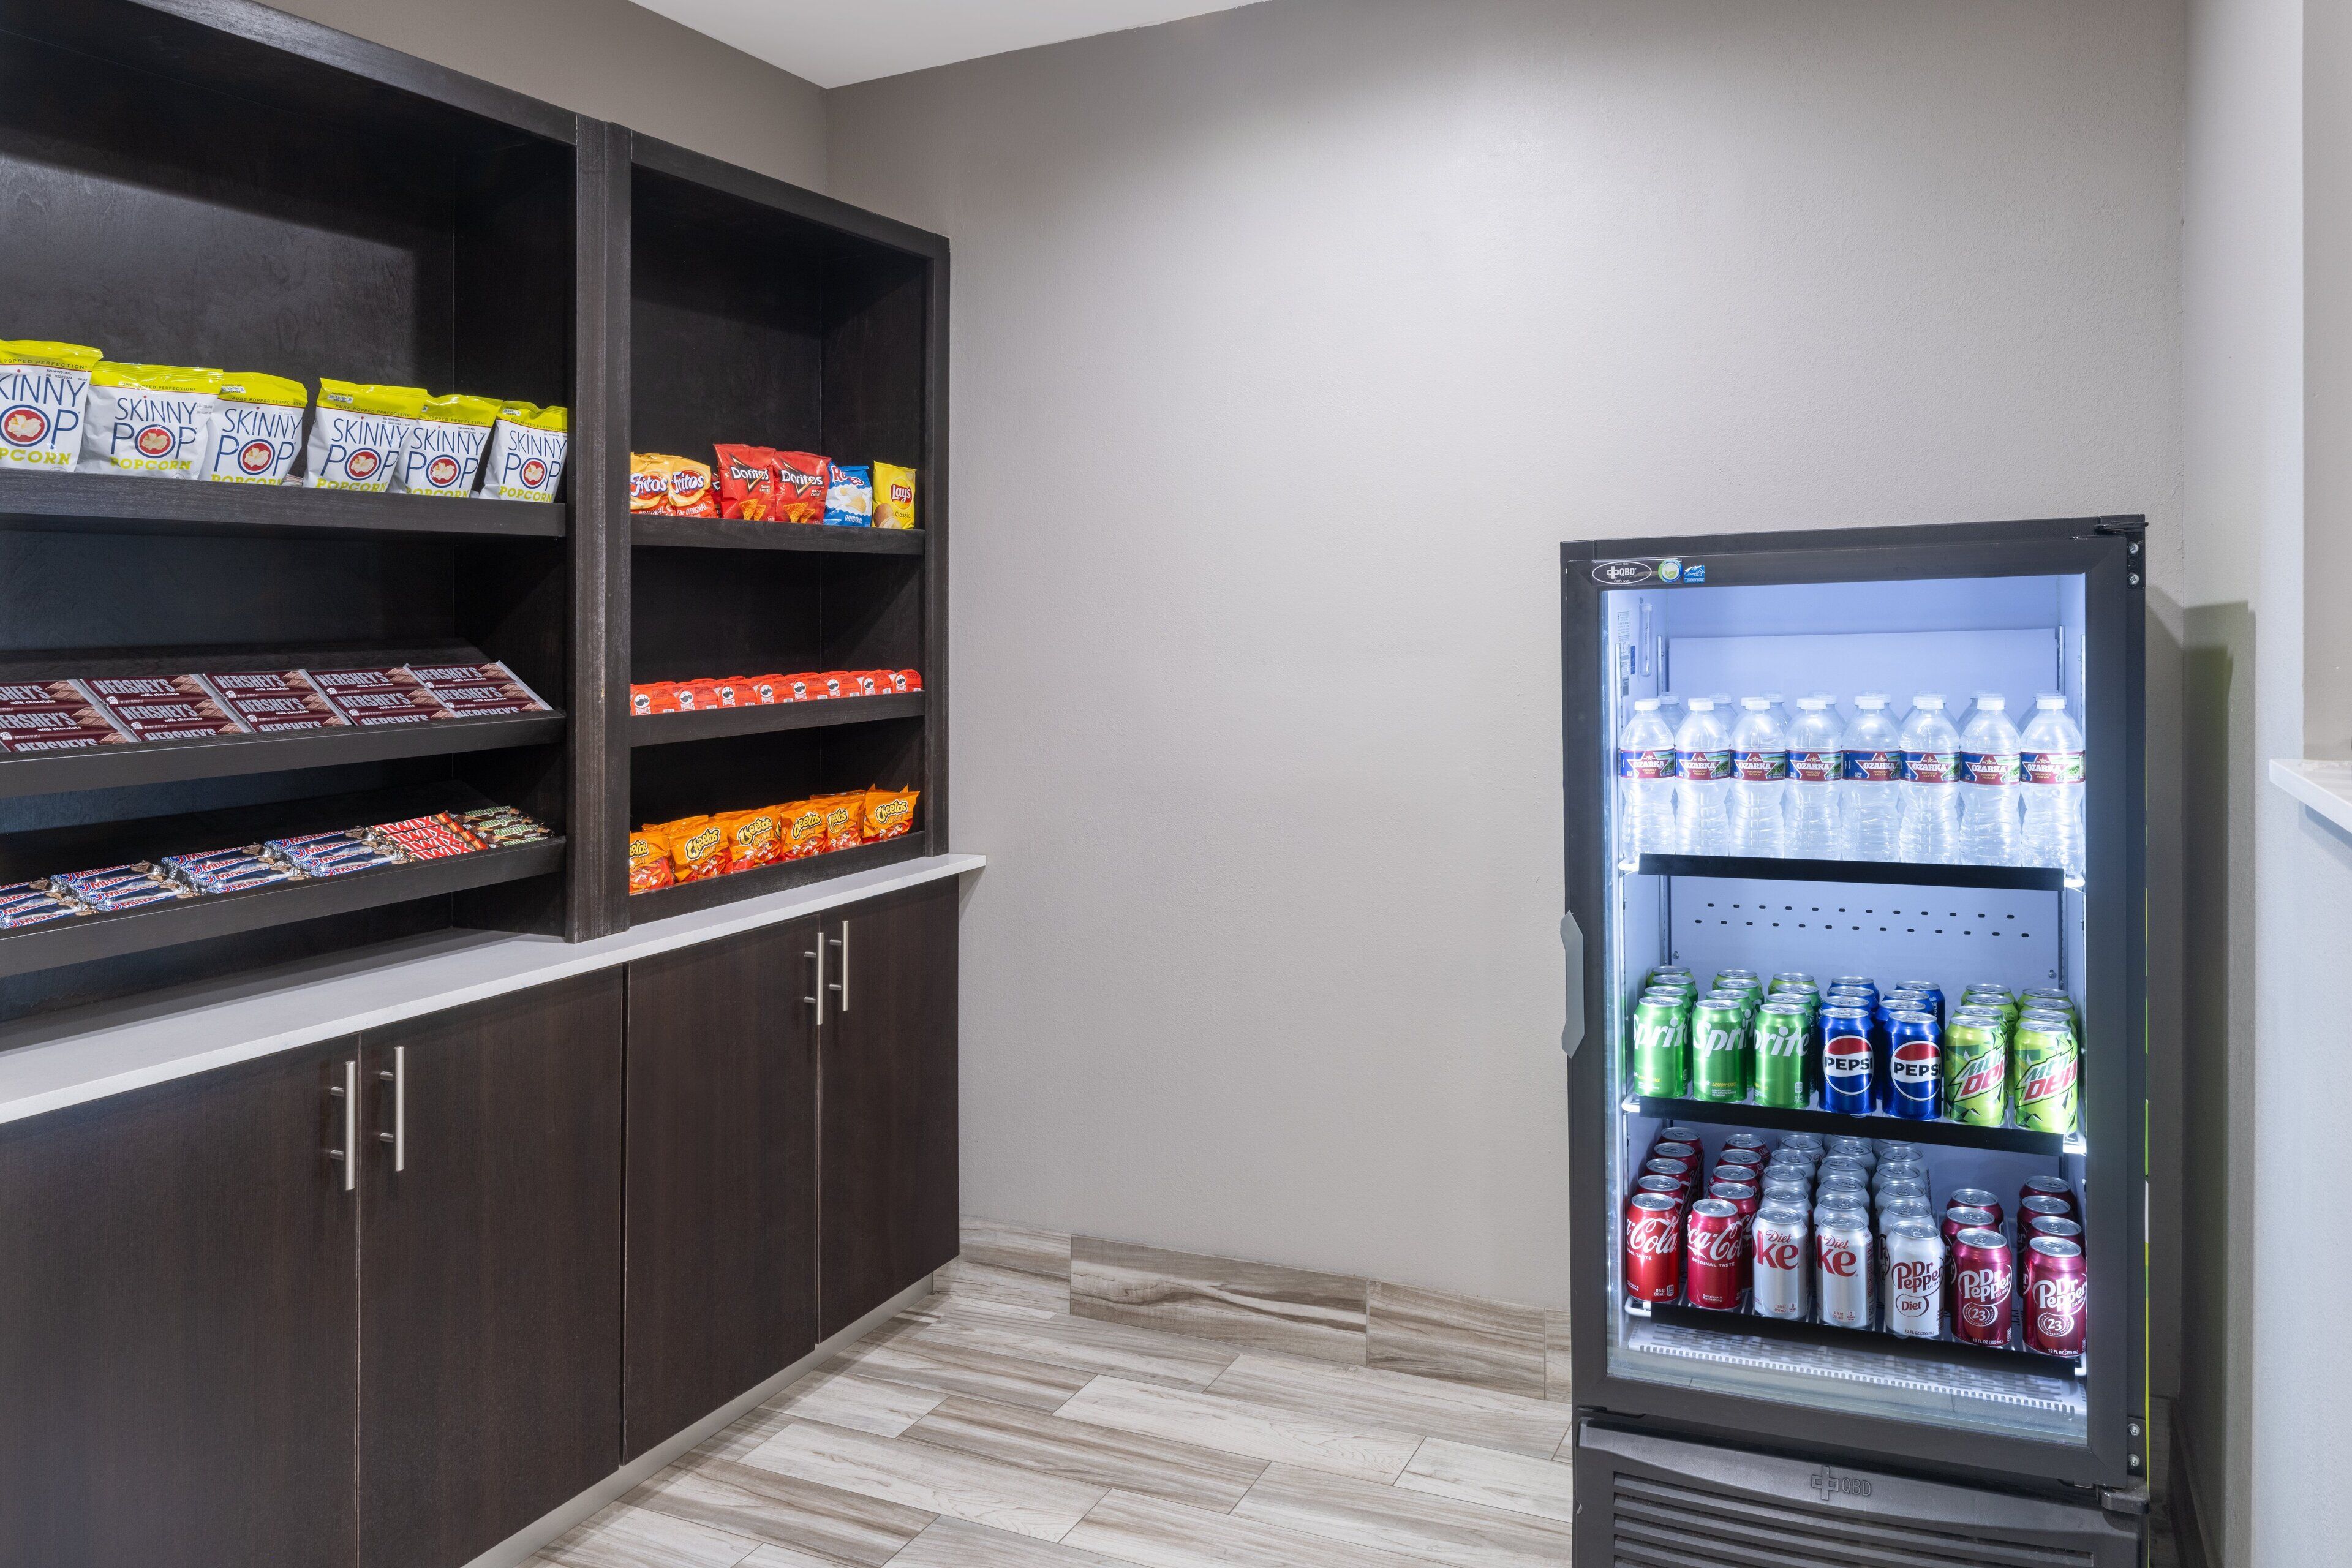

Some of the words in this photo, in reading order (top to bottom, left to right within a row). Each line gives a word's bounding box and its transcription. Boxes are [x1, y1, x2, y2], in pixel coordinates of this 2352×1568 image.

[36, 360, 85, 369] PERFECTION
[0, 369, 86, 407] KINNY
[115, 395, 197, 424] SKINNY
[0, 404, 79, 450] OP
[222, 407, 303, 439] SKINNY
[111, 422, 197, 459] POP
[331, 417, 409, 448] SKINNY
[411, 425, 485, 455] SKINNY
[508, 429, 567, 459] SKINNY
[0, 447, 72, 465] PCORN
[109, 456, 192, 470] POPCORN
[214, 434, 295, 476] POP
[320, 444, 399, 481] POP
[405, 451, 478, 488] POP
[503, 452, 561, 491] POP
[731, 466, 769, 480] Doritos
[781, 470, 823, 484] Doritos
[671, 471, 704, 494] Fritos
[499, 486, 554, 502] POPCORN
[892, 484, 911, 503] Lay's
[214, 674, 285, 689] HERSHEY'S
[315, 671, 390, 687] HERSHEY'S
[413, 666, 483, 682] HERSHEY'S
[0, 685, 50, 701] SHEY'S
[92, 679, 175, 695] HERSHEY'S
[434, 687, 503, 701] HERSHEY'S
[235, 698, 306, 713] HERSHEY'S
[337, 693, 412, 708] HERSHEY'S
[117, 704, 199, 720] HERSHEY'S
[1972, 765, 2007, 774] OZARKA
[2027, 764, 2062, 773] OZARKA
[875, 799, 908, 824] Cheetos
[373, 816, 440, 834] TWIX
[738, 816, 772, 846] Cheetos
[792, 812, 822, 839] Ceetos
[276, 838, 288, 848] 3
[383, 826, 452, 843] TWIX
[396, 834, 464, 851] TWIX
[408, 842, 475, 860] TWIX
[685, 828, 720, 860] Cheetos
[174, 855, 185, 864] 3
[292, 848, 304, 858] 3
[63, 872, 74, 881] 3
[189, 864, 200, 874] 3
[78, 882, 90, 892] 3
[1694, 1018, 1746, 1057] Spri
[1755, 1027, 1810, 1057] prite
[1825, 1057, 1873, 1071] PEPSI
[1765, 1230, 1792, 1243] Diet
[1823, 1235, 1849, 1250] Diet
[1692, 1257, 1717, 1267] ORIGINAL
[1817, 1234, 1858, 1277] ke
[1892, 1262, 1943, 1293] Pepper
[1912, 1261, 1934, 1278] Dr
[1979, 1269, 2002, 1286] Dr
[1958, 1270, 2010, 1302] Pepper
[2056, 1278, 2078, 1295] Dr
[2034, 1280, 2086, 1312] Pepper
[1901, 1301, 1922, 1311] Diet
[1972, 1308, 1986, 1321] 23
[2048, 1319, 2062, 1331] 23
[1842, 1477, 1872, 1496] QBD
